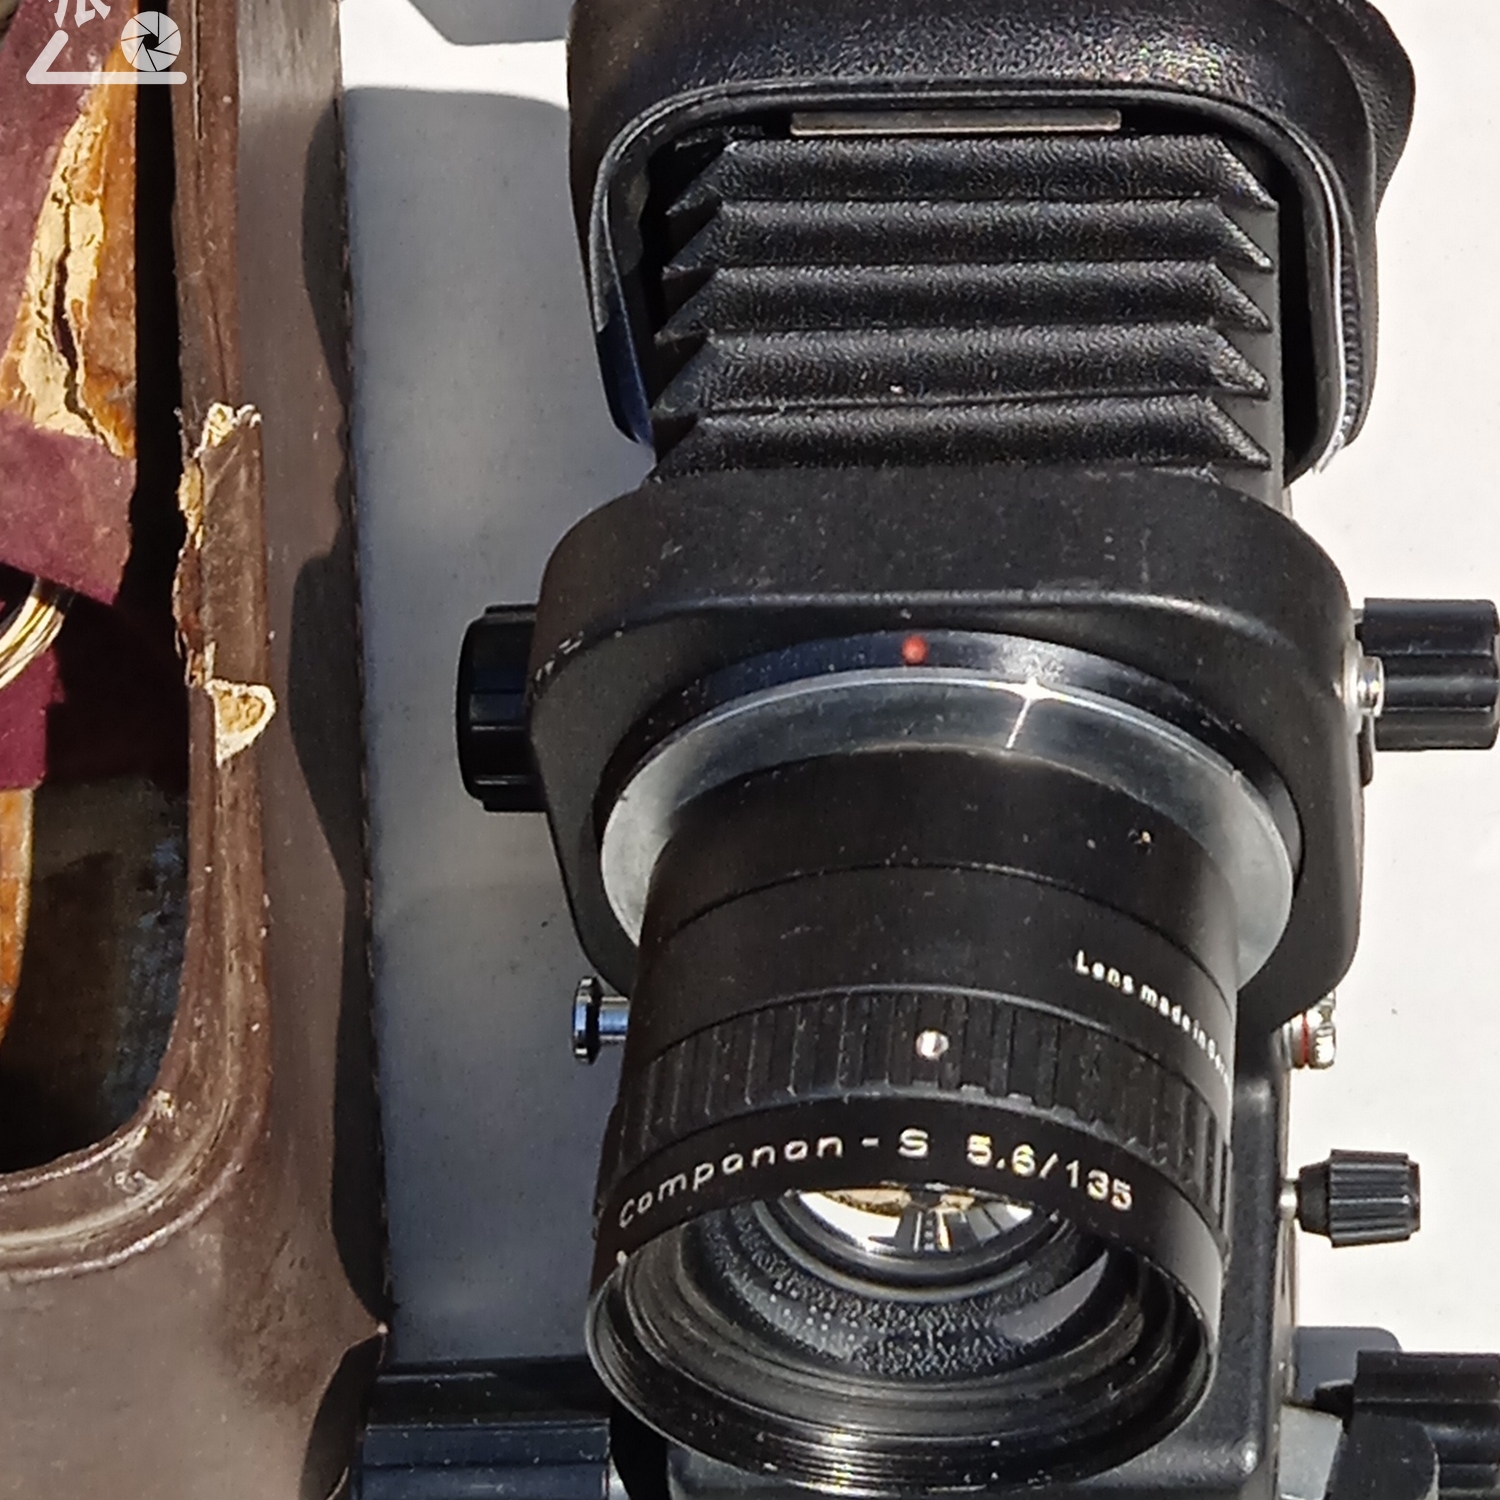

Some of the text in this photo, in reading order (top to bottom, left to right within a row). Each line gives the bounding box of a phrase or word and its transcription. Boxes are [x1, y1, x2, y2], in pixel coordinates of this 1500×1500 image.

[1075, 949, 1134, 994] Lens
[1140, 984, 1191, 1033] made
[966, 1133, 1133, 1211] 5.6/135
